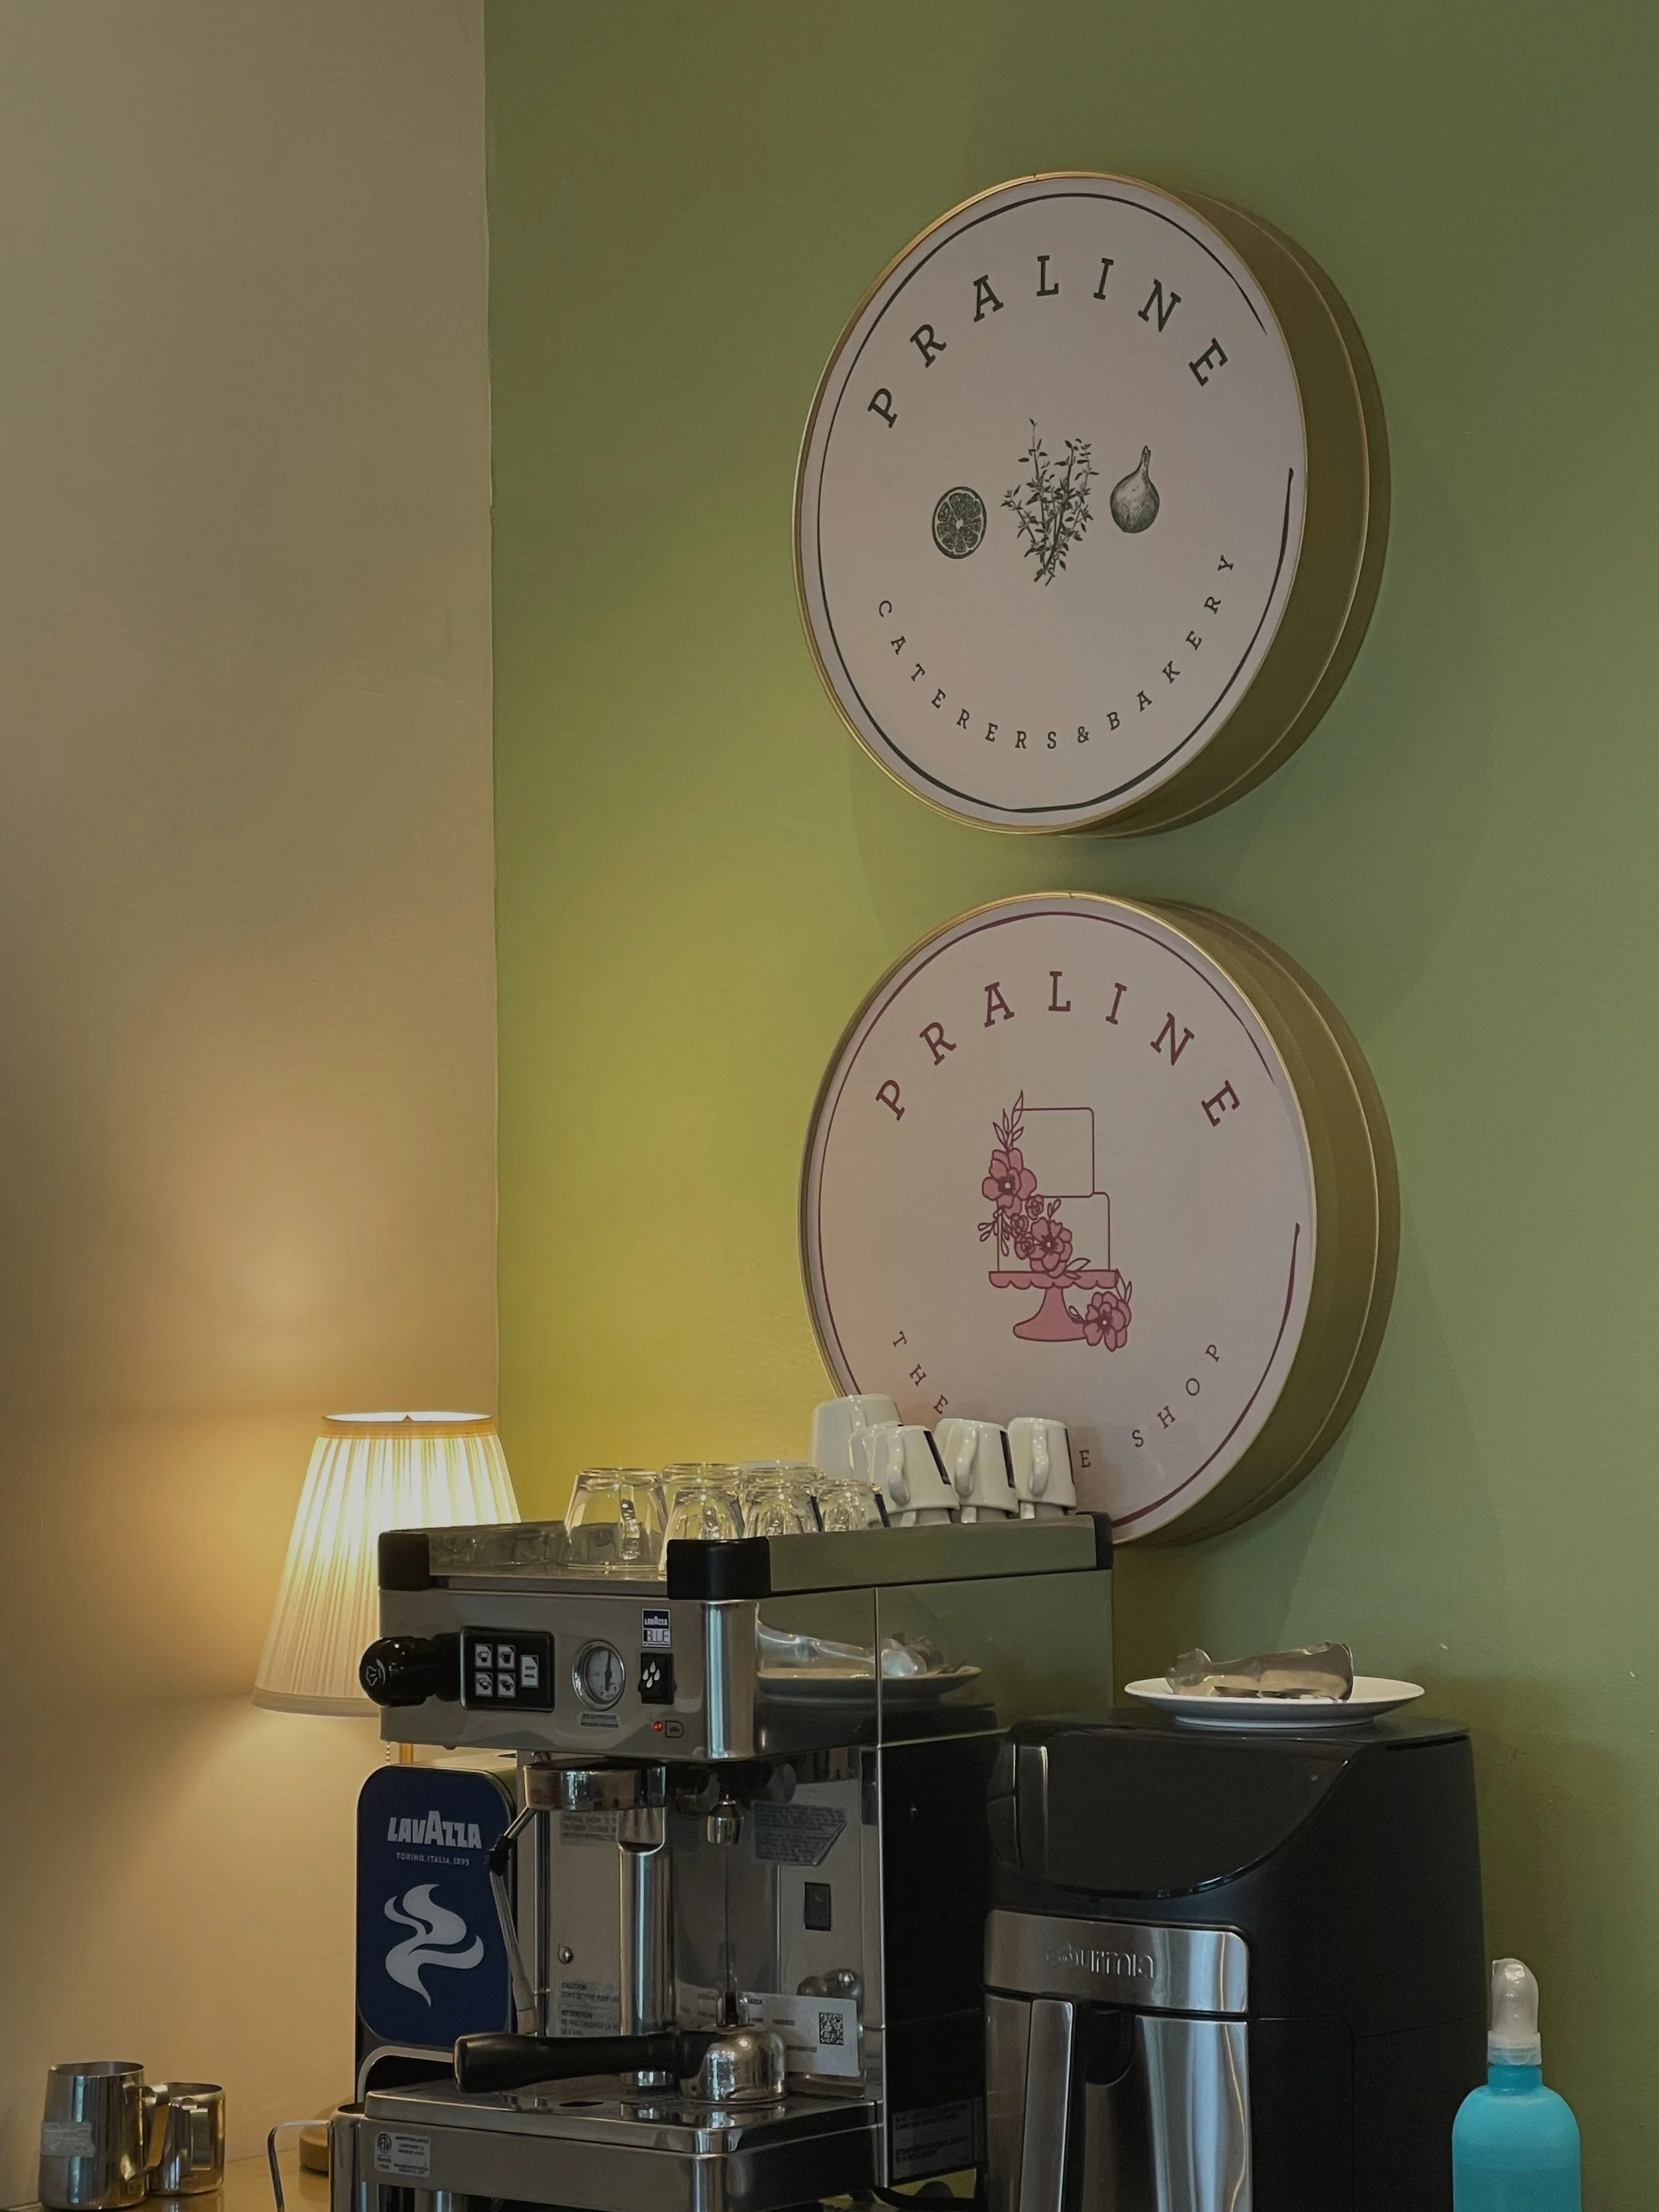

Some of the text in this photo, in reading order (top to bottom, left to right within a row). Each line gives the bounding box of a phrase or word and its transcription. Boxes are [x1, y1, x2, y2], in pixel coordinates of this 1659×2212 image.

[868, 255, 1229, 429] PRALINE
[875, 971, 1241, 1128] PRALINE
[893, 1330, 1221, 1448] THE SHOP
[644, 1629, 670, 1643] BLUE
[387, 1810, 482, 1850] LAVAZZA
